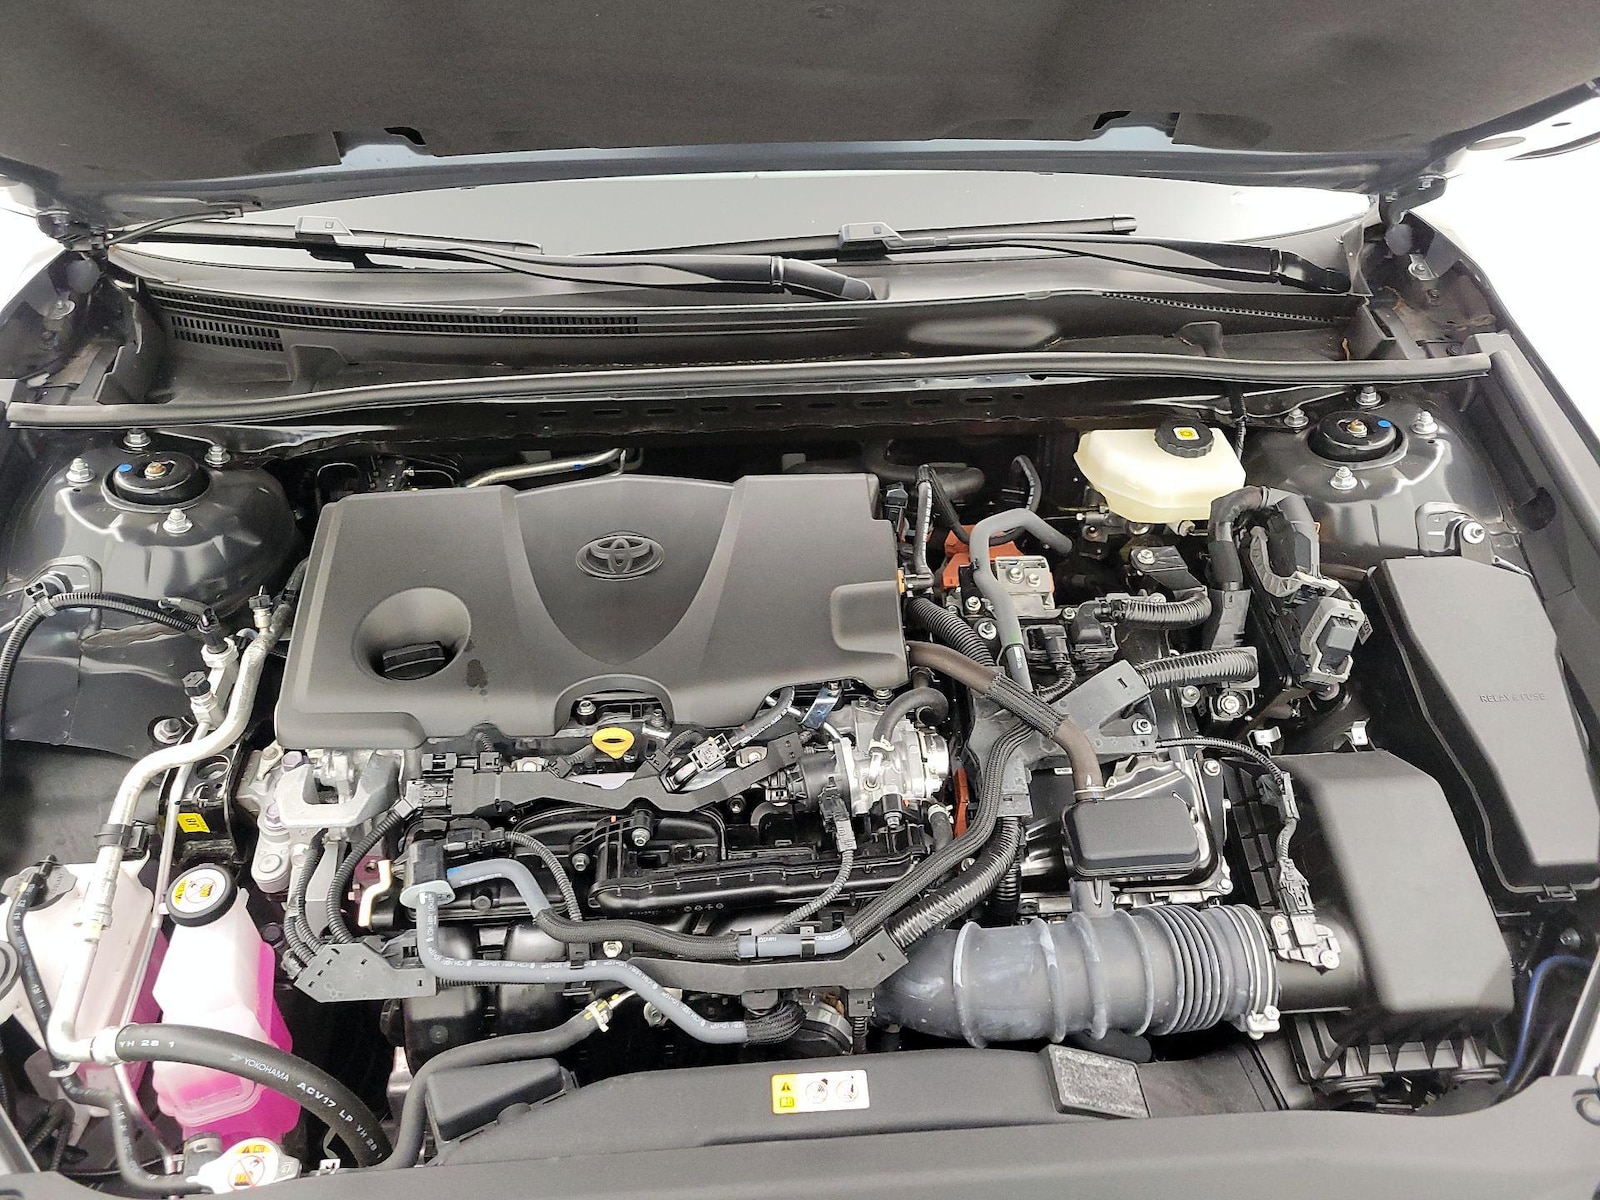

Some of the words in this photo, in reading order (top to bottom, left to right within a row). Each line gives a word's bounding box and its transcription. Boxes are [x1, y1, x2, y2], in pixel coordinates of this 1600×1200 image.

[1479, 694, 1510, 703] RELAY
[1520, 692, 1546, 701] FUSE
[244, 1058, 290, 1082] YOKOHAMA
[297, 1082, 337, 1107] ACV17
[339, 1109, 354, 1122] LP
